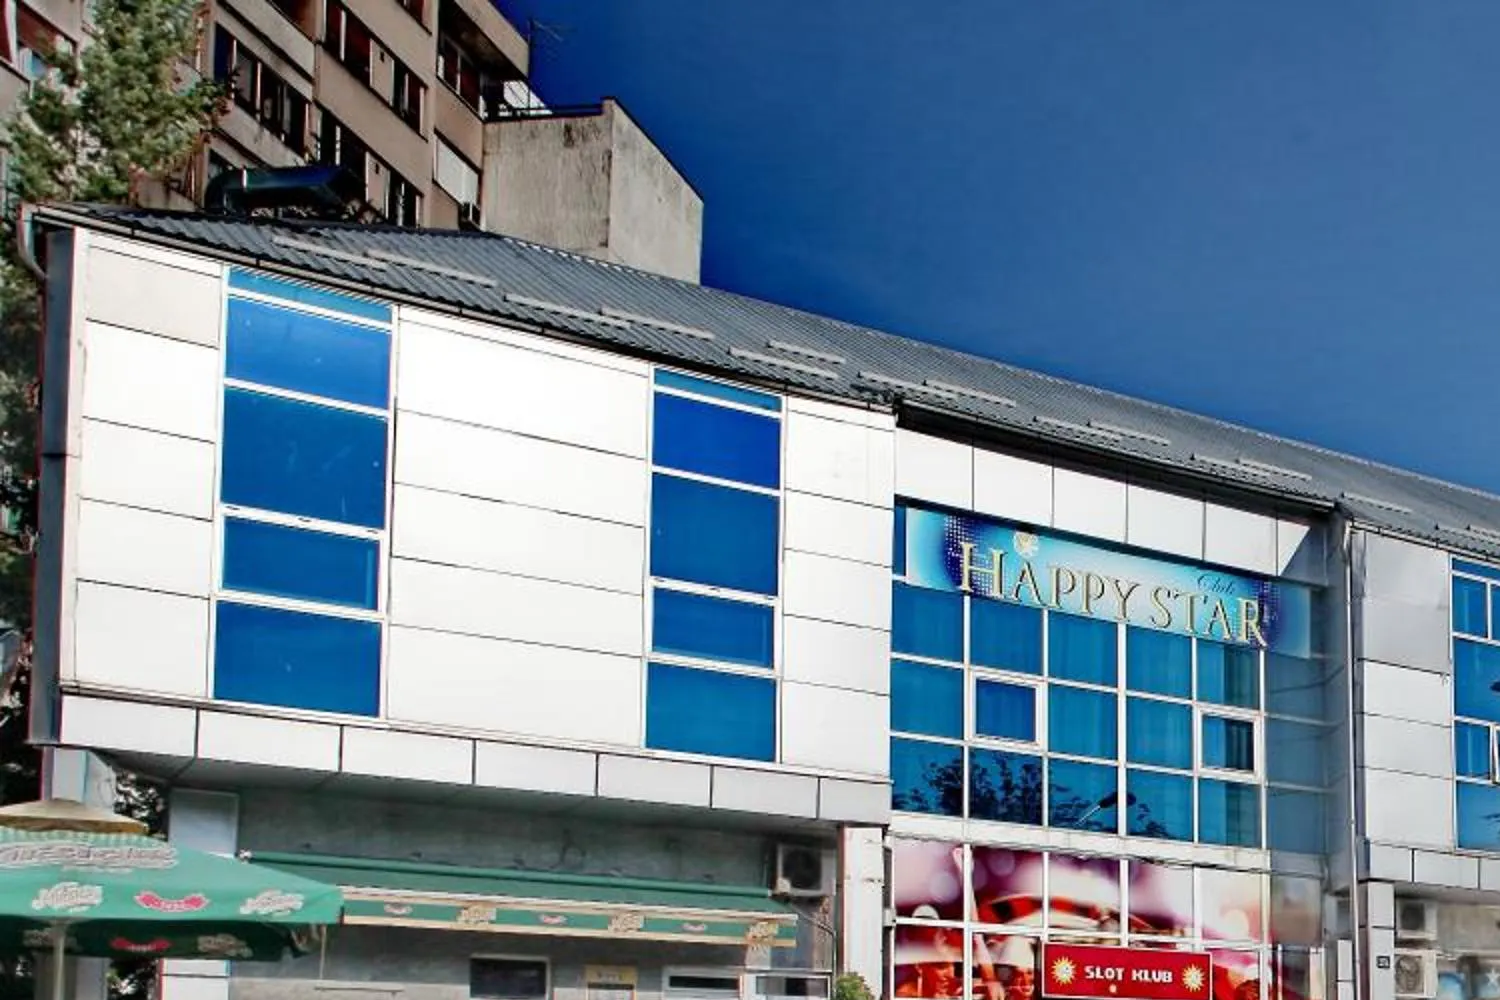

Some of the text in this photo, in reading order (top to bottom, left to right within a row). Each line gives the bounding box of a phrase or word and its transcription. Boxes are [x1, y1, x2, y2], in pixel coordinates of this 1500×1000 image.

[958, 541, 1268, 648] HAPPY STAR
[1198, 572, 1234, 596] Club
[1084, 964, 1173, 983] SLOT KLUB
